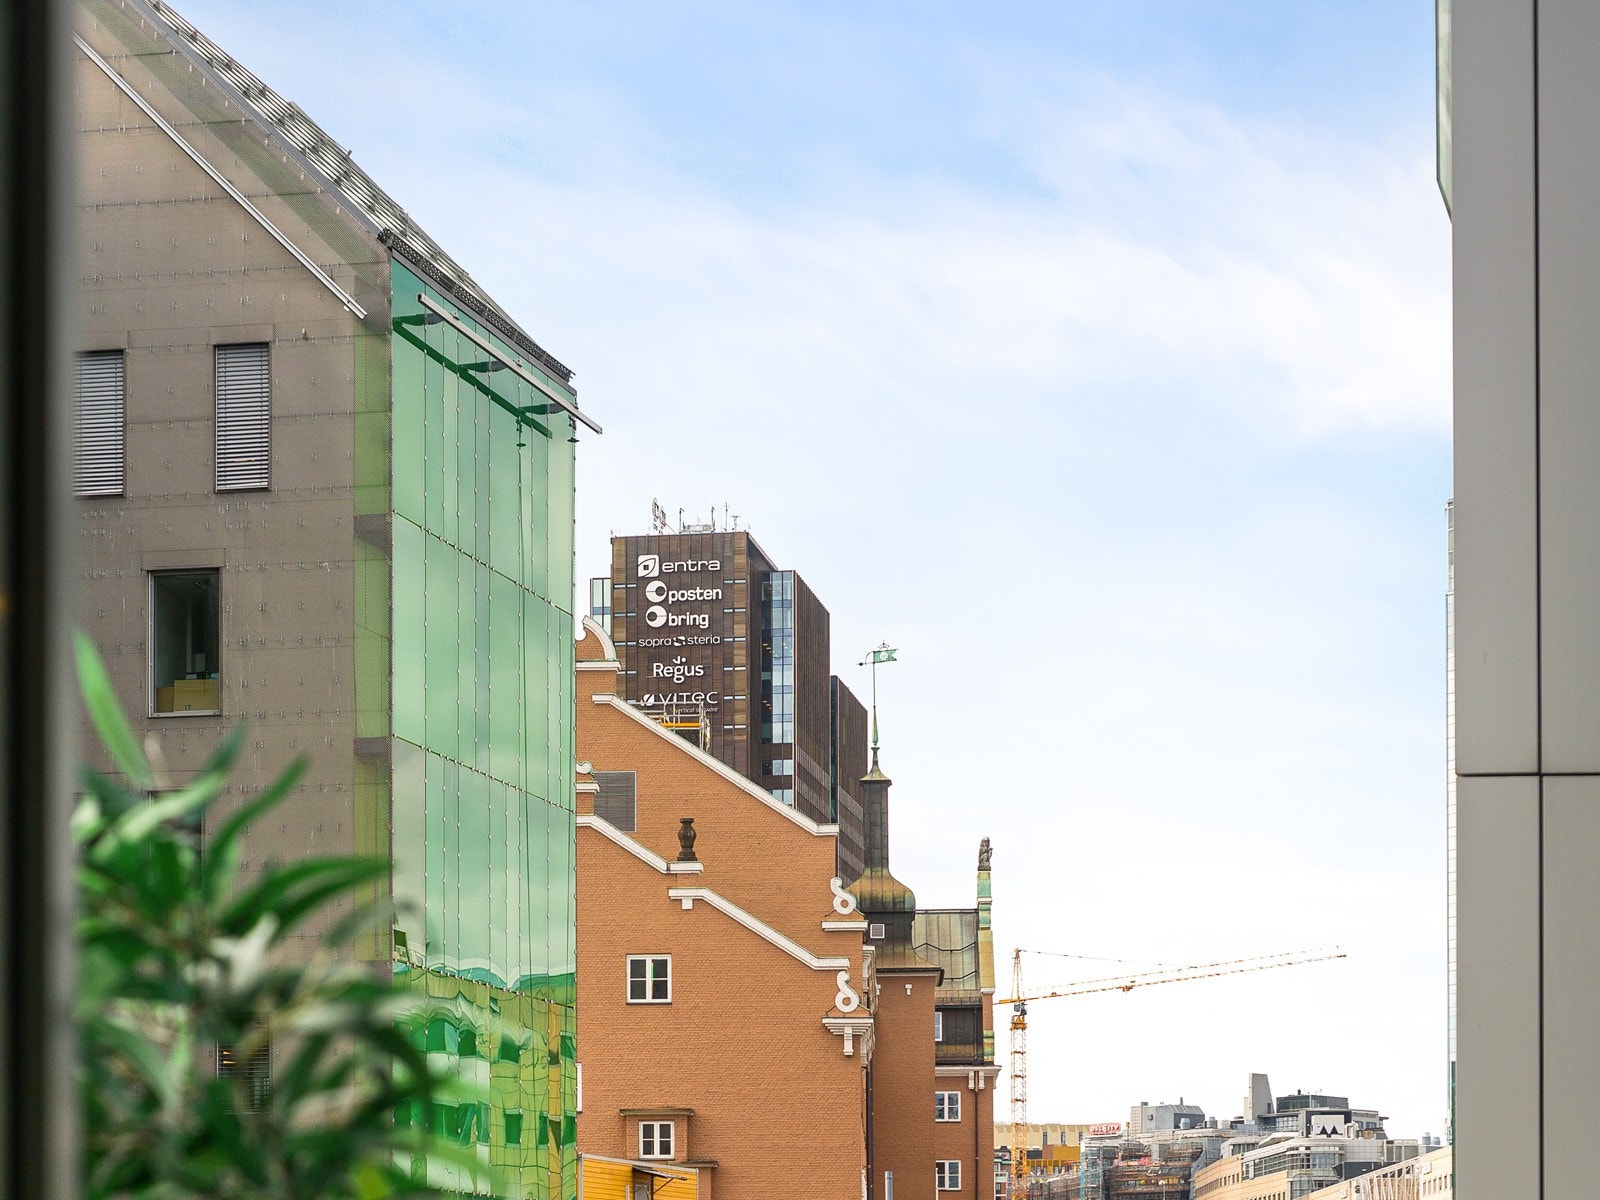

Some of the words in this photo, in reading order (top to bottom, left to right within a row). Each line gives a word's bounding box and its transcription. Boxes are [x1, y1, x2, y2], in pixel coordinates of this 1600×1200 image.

[661, 559, 721, 573] entra
[668, 586, 722, 605] posten
[668, 611, 709, 629] bring
[638, 638, 672, 648] sopra
[687, 634, 721, 645] steria
[653, 662, 705, 684] Regus
